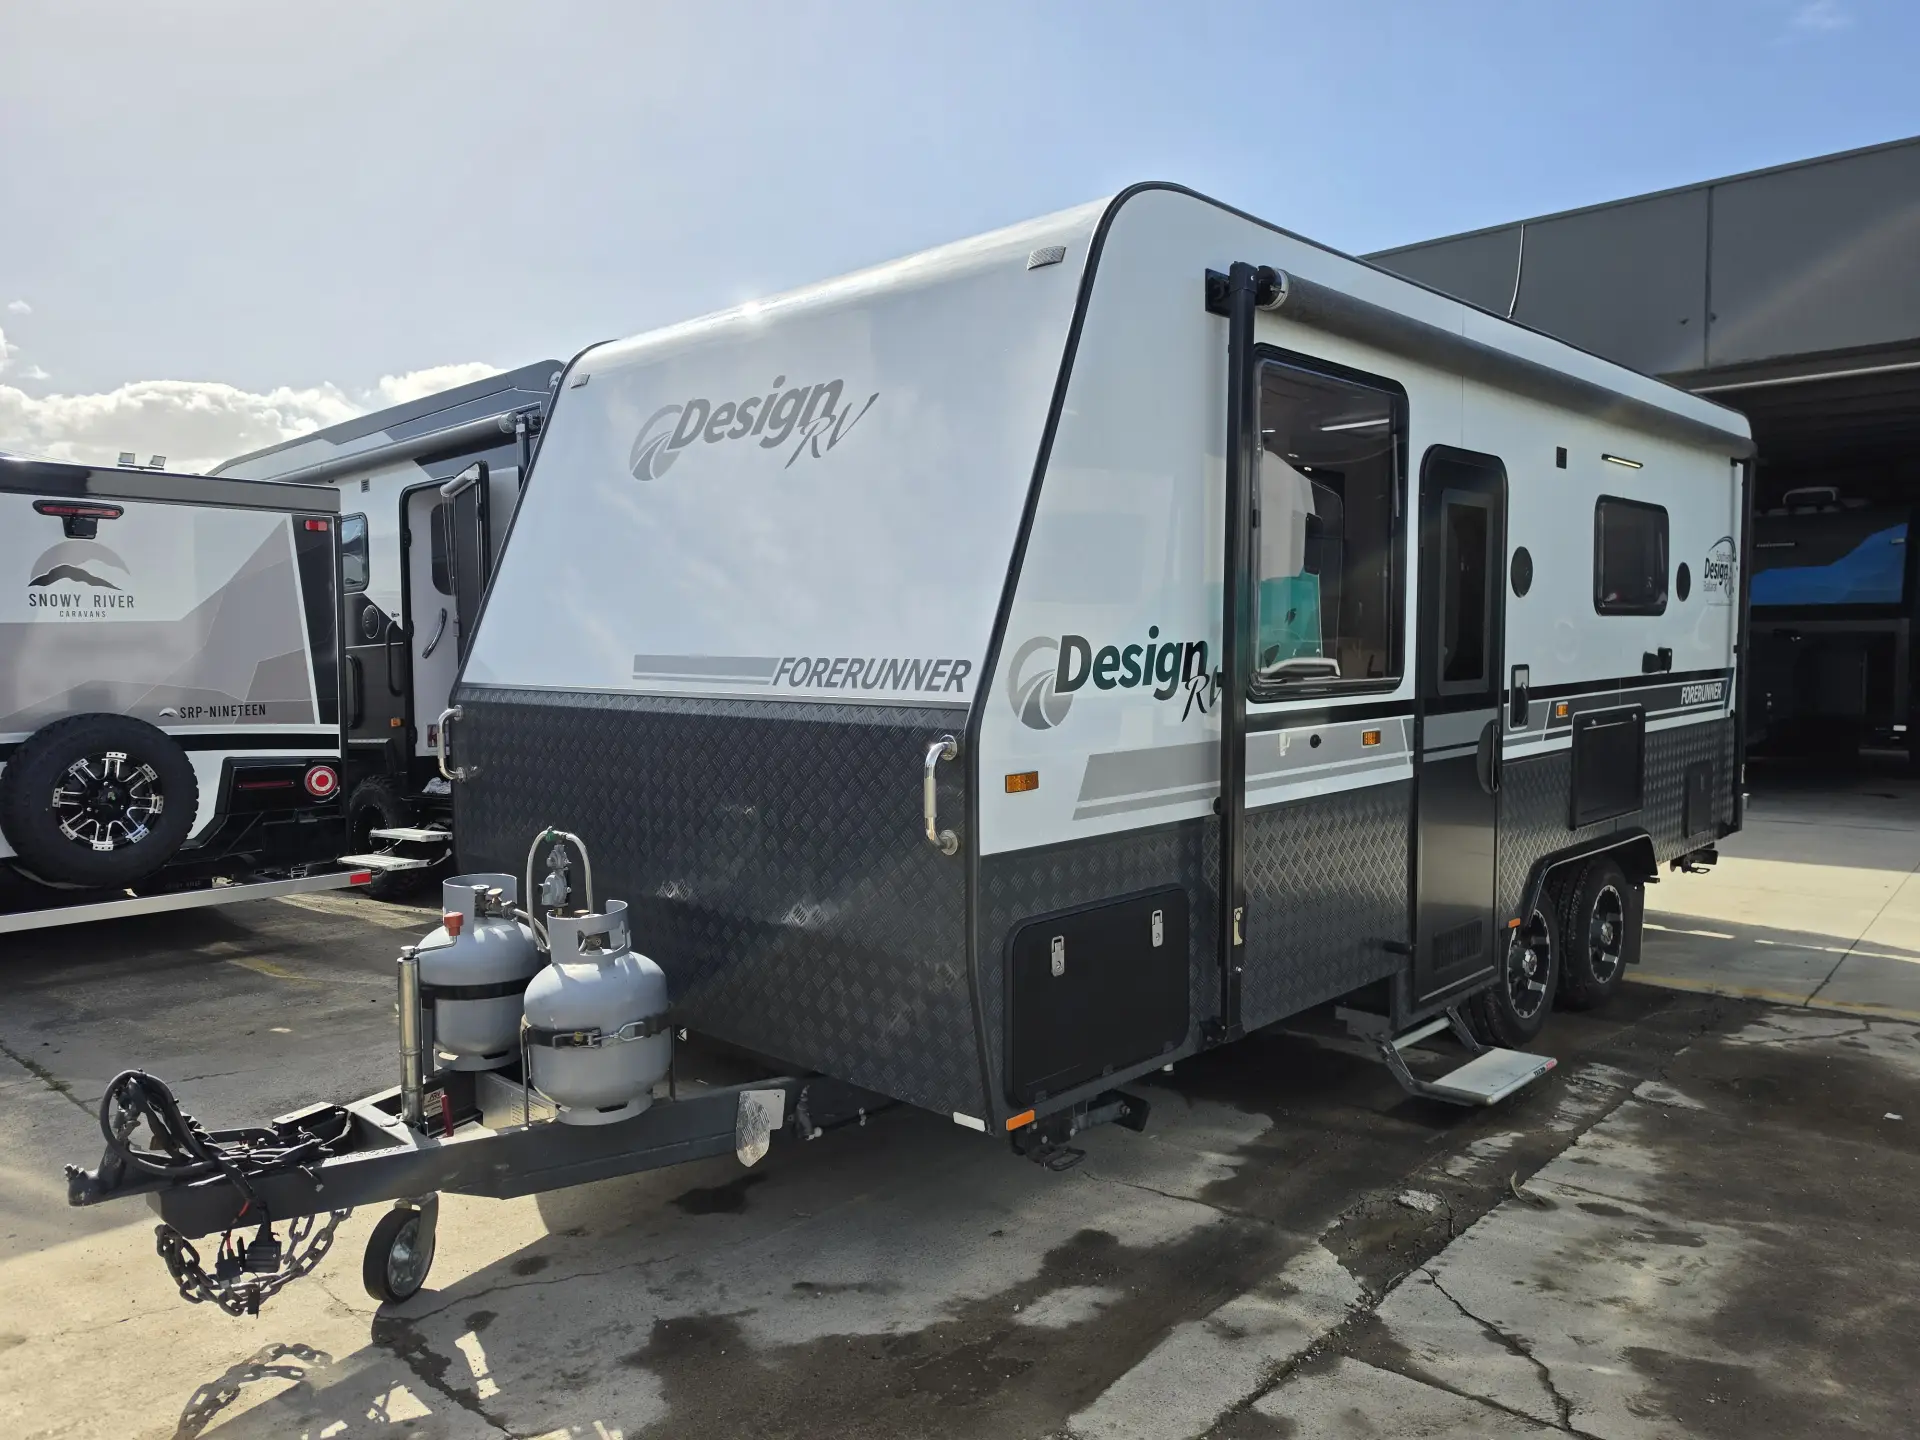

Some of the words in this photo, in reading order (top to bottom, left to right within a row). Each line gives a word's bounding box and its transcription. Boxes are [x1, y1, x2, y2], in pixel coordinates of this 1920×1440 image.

[667, 375, 844, 450] Design
[785, 392, 879, 470] RV
[1704, 557, 1729, 586] Design
[29, 593, 82, 608] SNOWY
[93, 595, 135, 609] RIVER
[59, 610, 106, 618] CARAVANS
[772, 656, 972, 693] FORERUNNER
[1055, 625, 1209, 701] Design
[1680, 682, 1722, 705] FORERUNNER
[180, 704, 266, 719] SRP-NINETEEN
